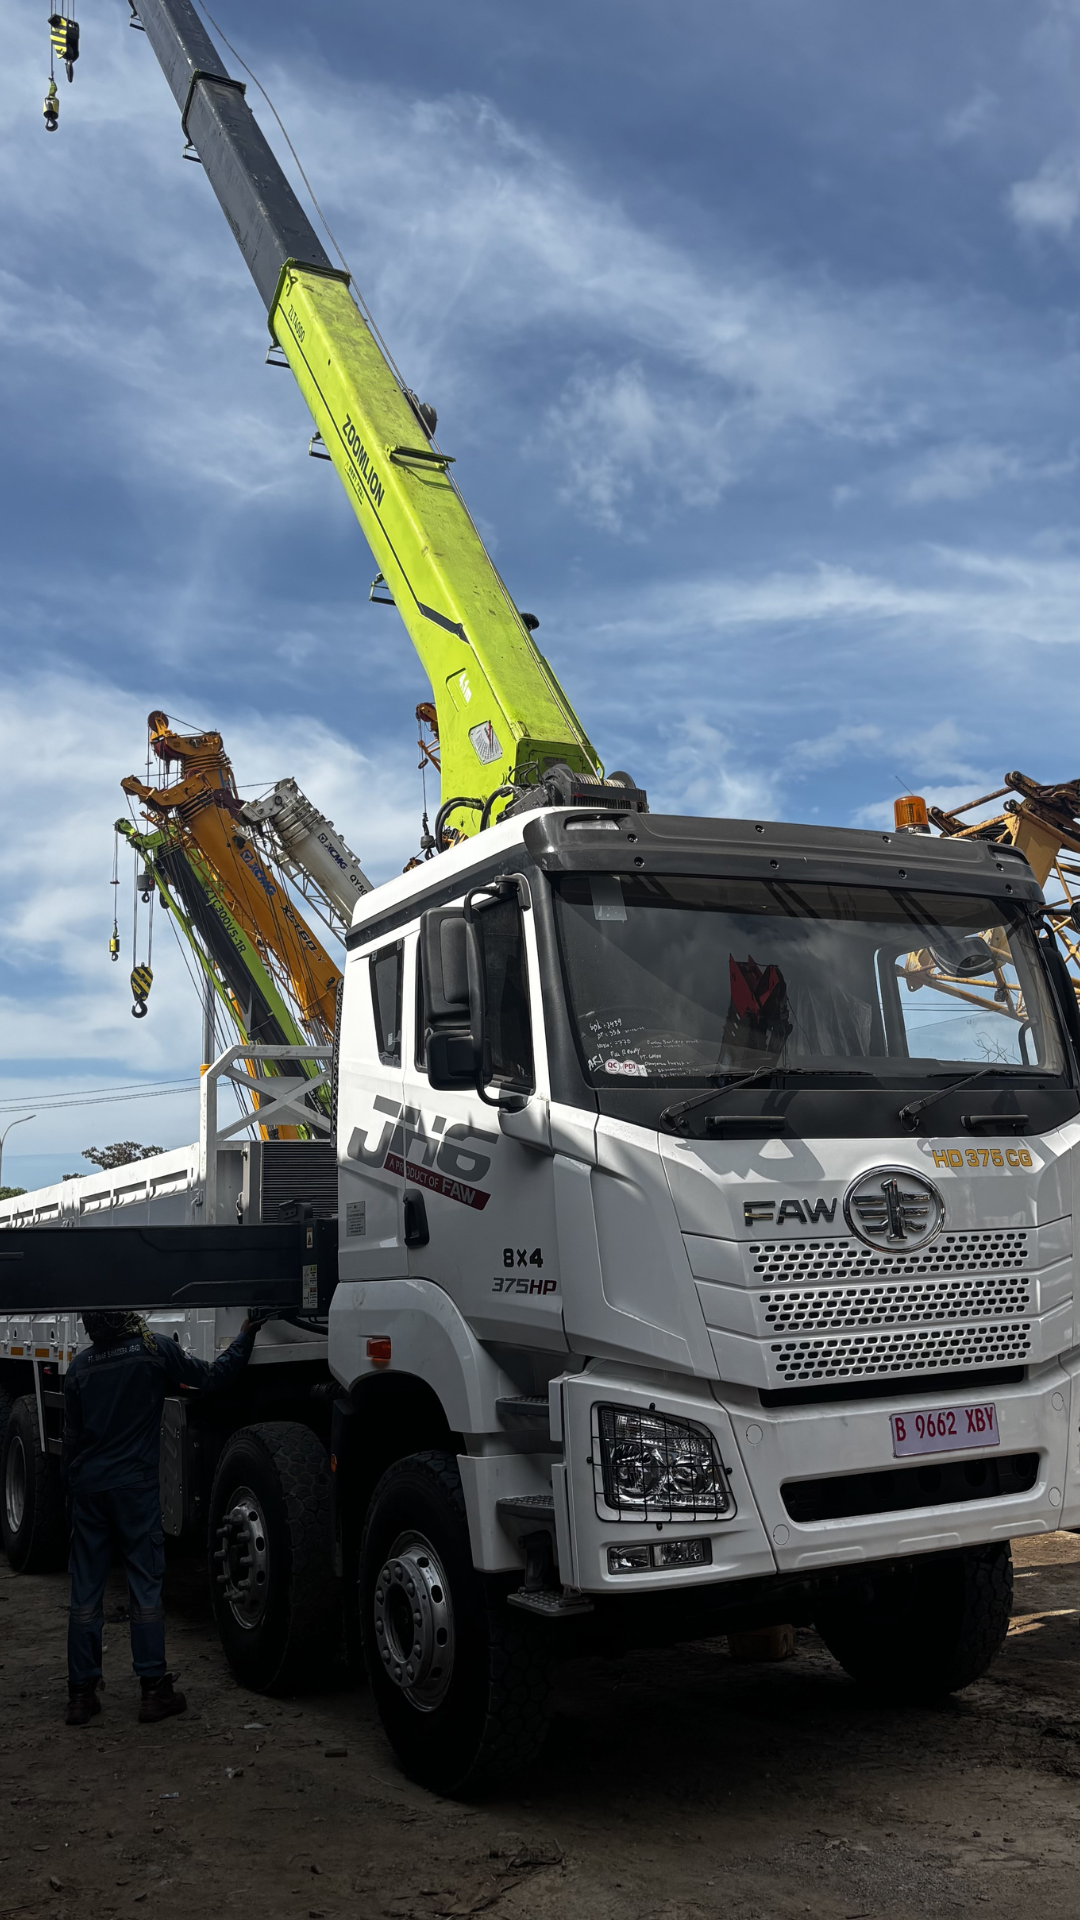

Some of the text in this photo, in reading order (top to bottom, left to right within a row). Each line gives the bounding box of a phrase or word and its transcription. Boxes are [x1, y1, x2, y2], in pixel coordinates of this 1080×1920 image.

[342, 413, 385, 508] ZOOMLION
[325, 842, 348, 869] XCMG
[249, 862, 276, 896] XCMG
[932, 1149, 1033, 1168] HD 375 CG
[395, 1161, 428, 1184] PRODUCT
[428, 1175, 439, 1189] OF
[442, 1178, 476, 1204] FAW
[743, 1197, 837, 1226] FAW
[503, 1247, 543, 1268] 8X4
[491, 1277, 557, 1295] 375HP
[895, 1406, 993, 1441] B 9662 XBY
